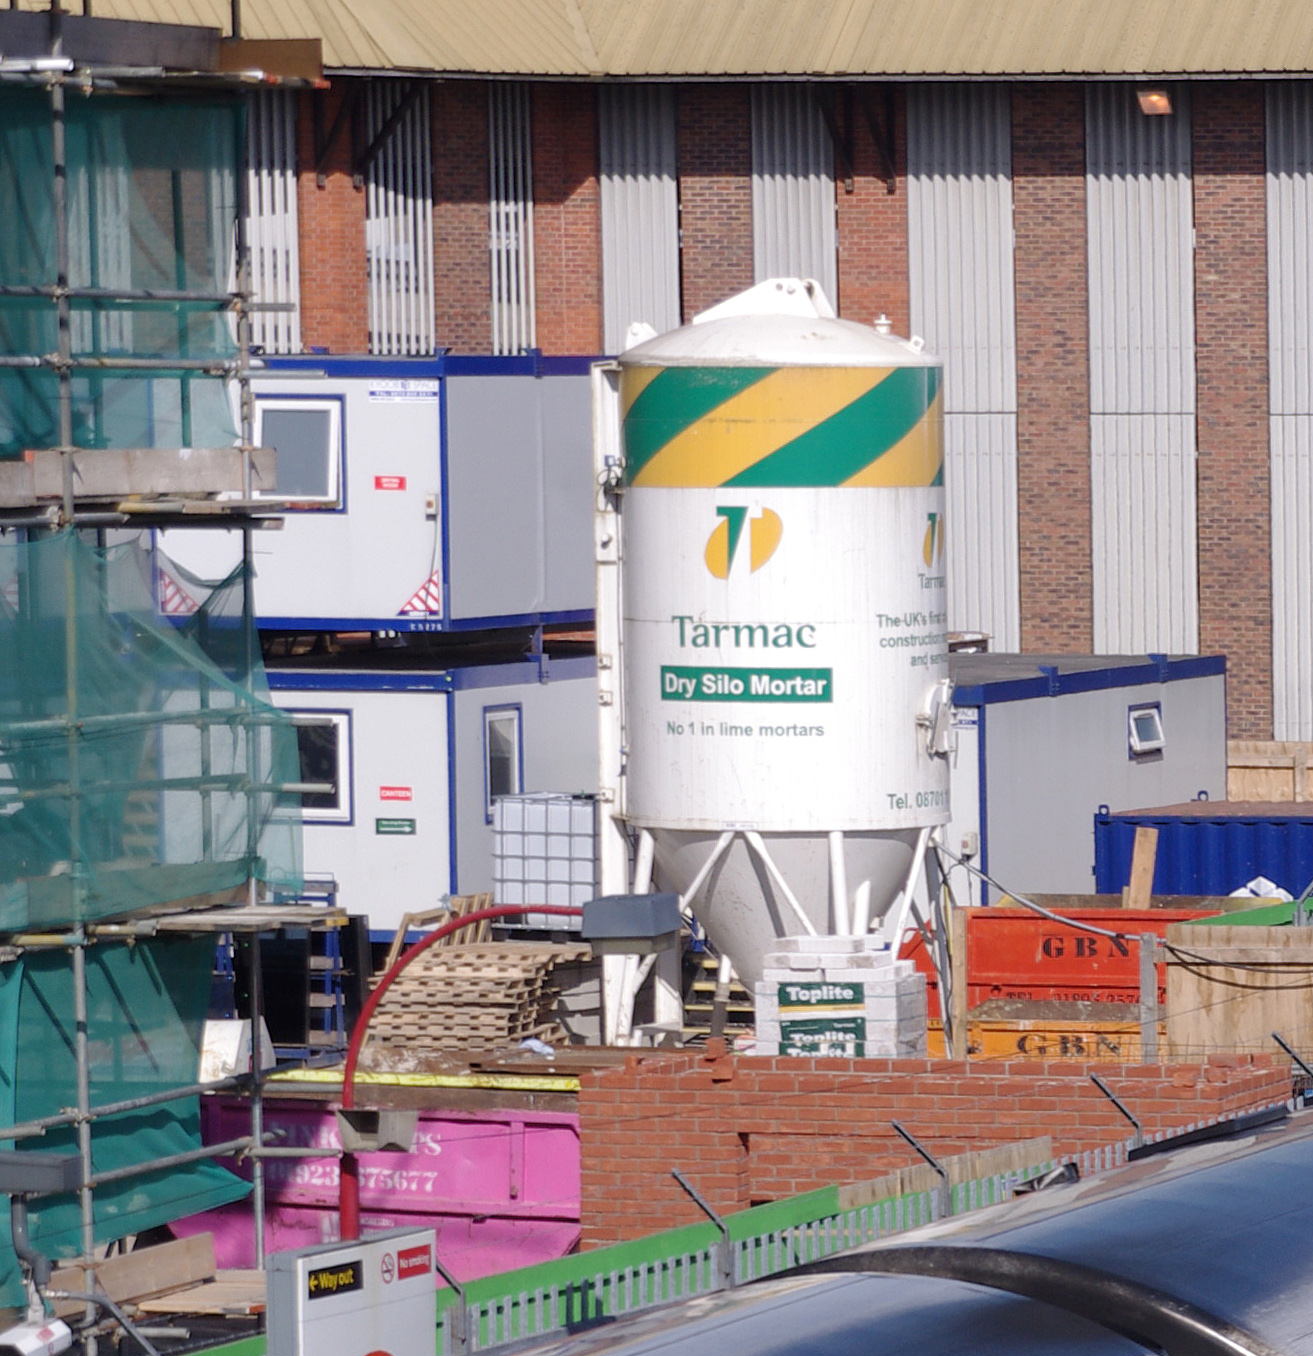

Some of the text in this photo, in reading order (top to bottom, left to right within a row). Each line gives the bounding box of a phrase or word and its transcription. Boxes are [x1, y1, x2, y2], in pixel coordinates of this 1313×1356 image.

[876, 614, 900, 627] The
[672, 615, 817, 648] Tarmac
[911, 654, 928, 667] and
[665, 673, 827, 698] Dry Silo Mortar
[667, 721, 825, 736] No 1 in lime mortars
[786, 985, 854, 1004] Toplite
[319, 1269, 354, 1291] Way out
